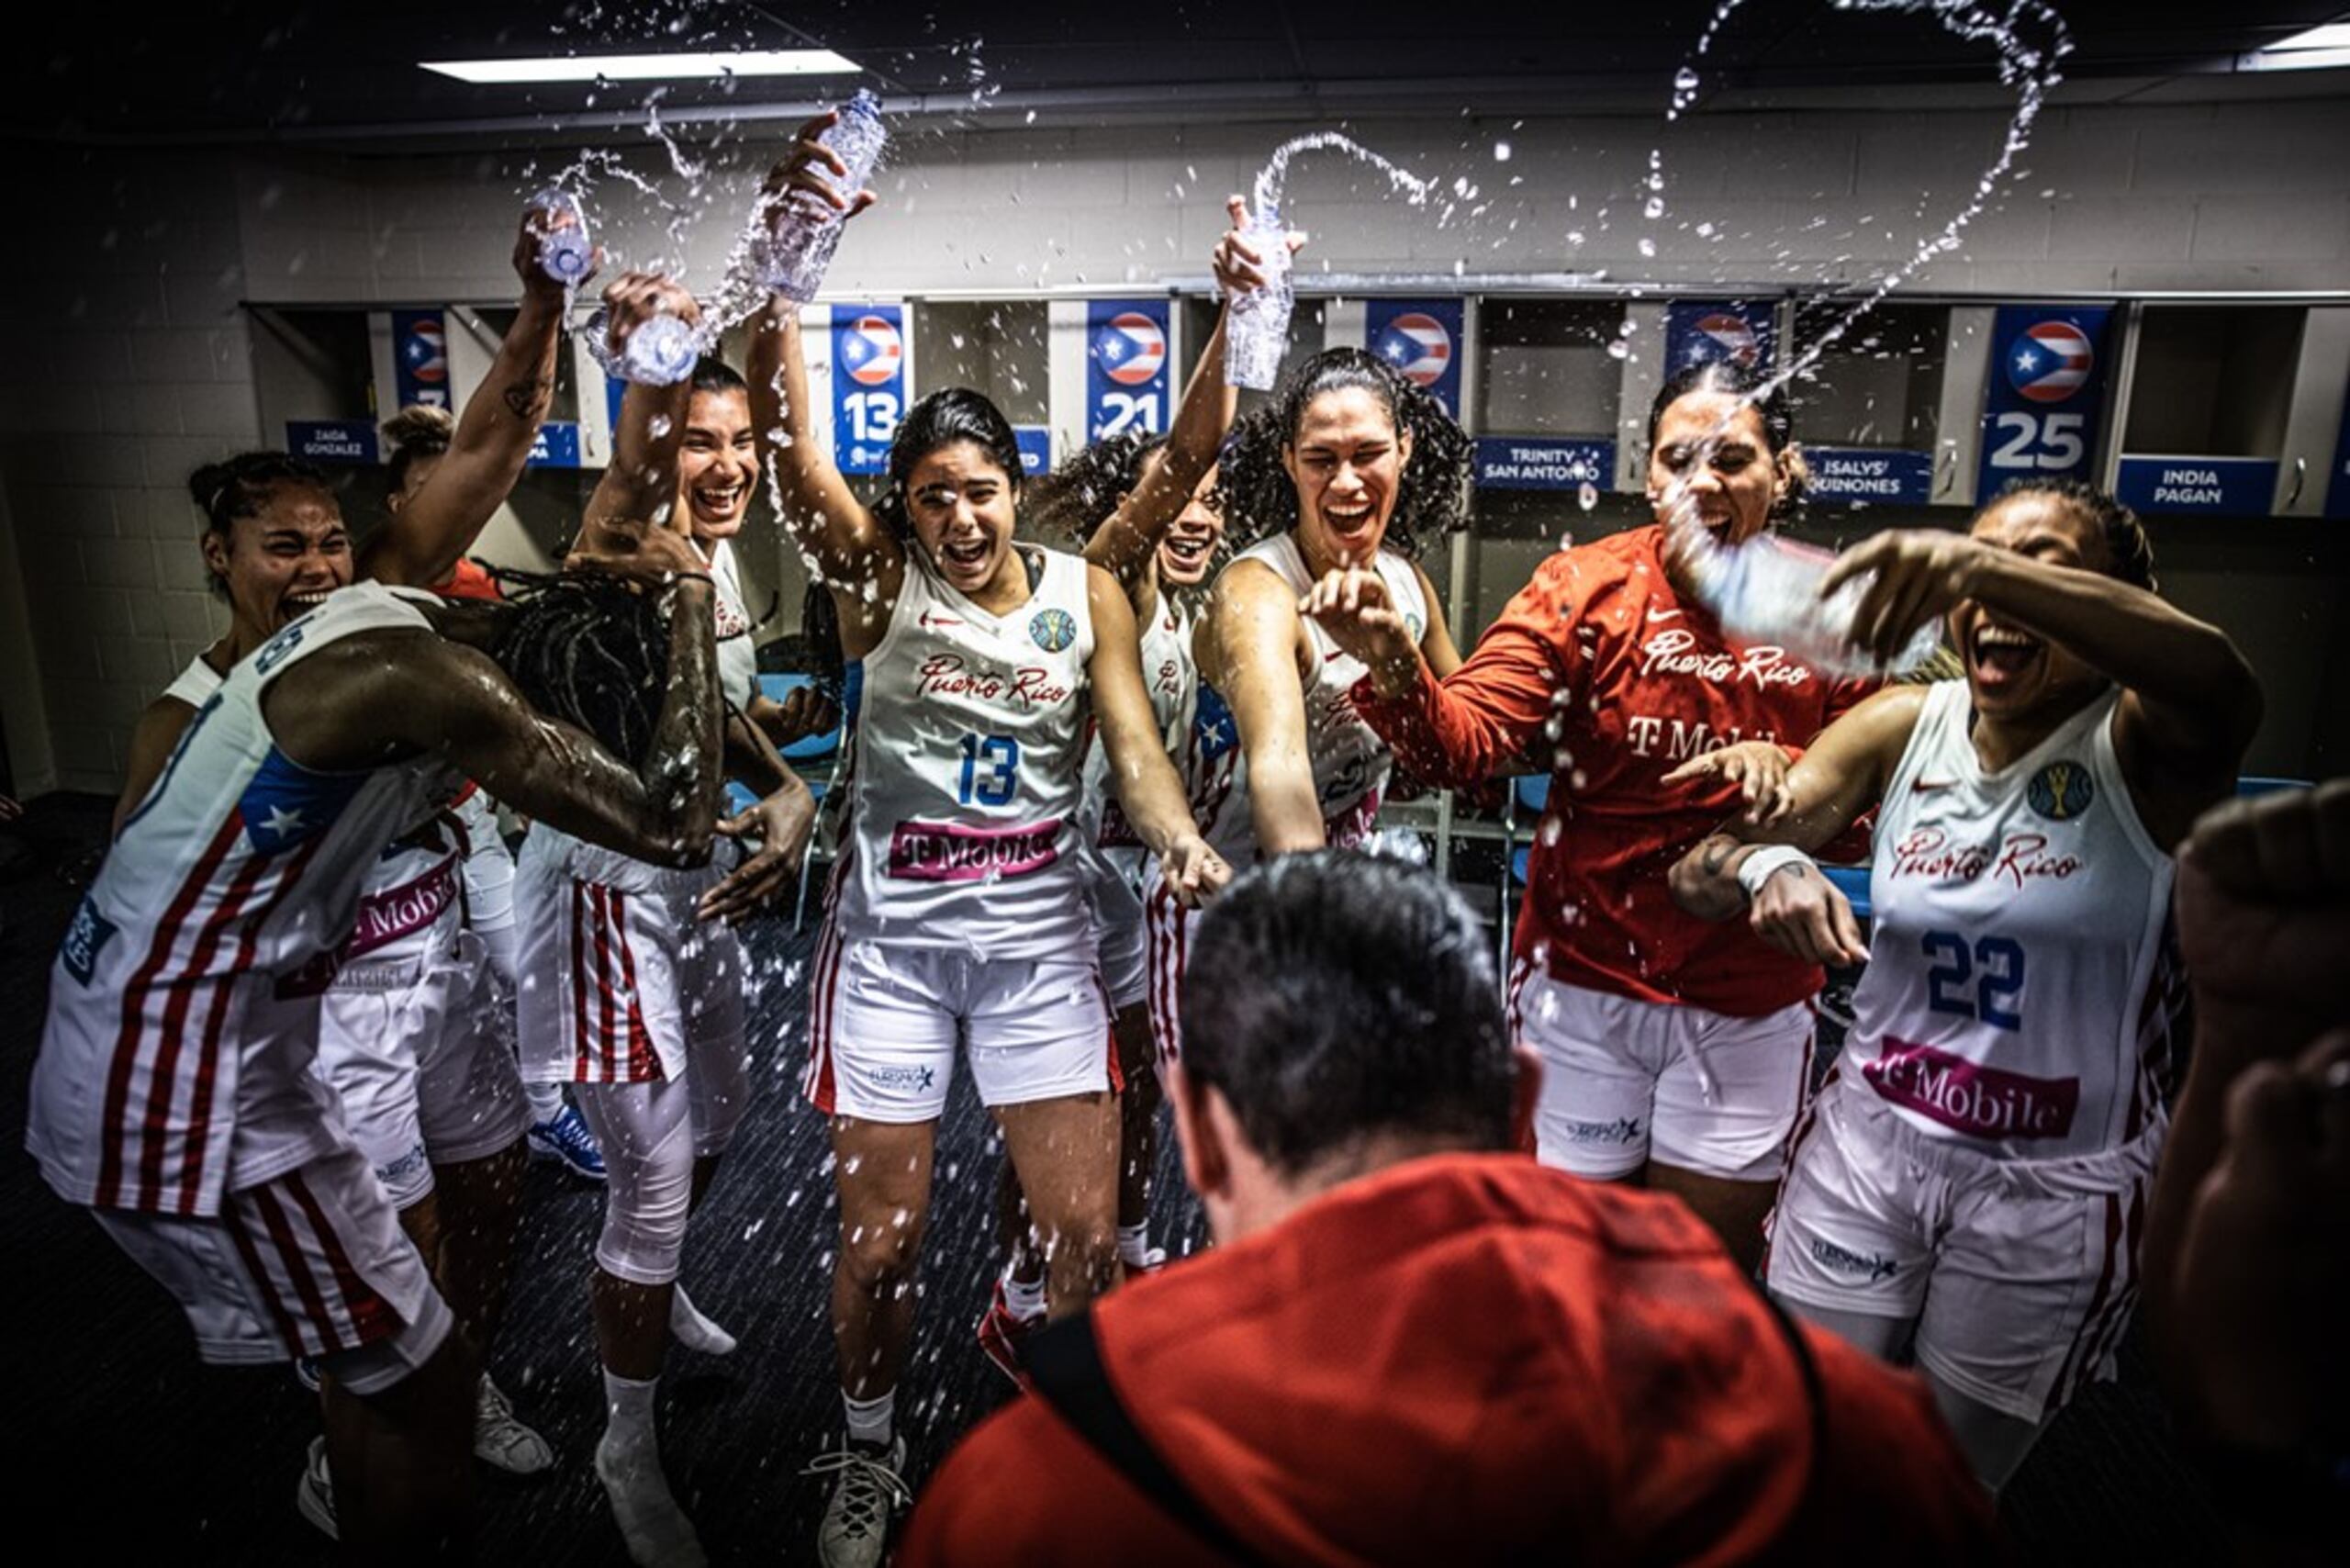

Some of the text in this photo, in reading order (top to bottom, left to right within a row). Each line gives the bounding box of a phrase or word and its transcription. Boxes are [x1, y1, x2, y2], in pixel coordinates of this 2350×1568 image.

[843, 392, 899, 442] 13
[1102, 392, 1158, 440] 21
[1990, 412, 2084, 469] 25
[304, 442, 363, 455] GONZALEZ
[1484, 464, 1518, 478] SAN
[1510, 448, 1575, 464] TRINITY
[2154, 488, 2222, 503] PAGAN
[2163, 470, 2218, 486] INDIA
[916, 653, 1073, 709] Puerto Rico
[1639, 629, 1810, 692] Puerto Rico
[959, 732, 1019, 808] 13
[933, 834, 1049, 869] Mobile
[1890, 828, 2081, 890] Puerto Rico
[1922, 930, 2026, 1032] 22
[1913, 1058, 2059, 1131] Mobile
